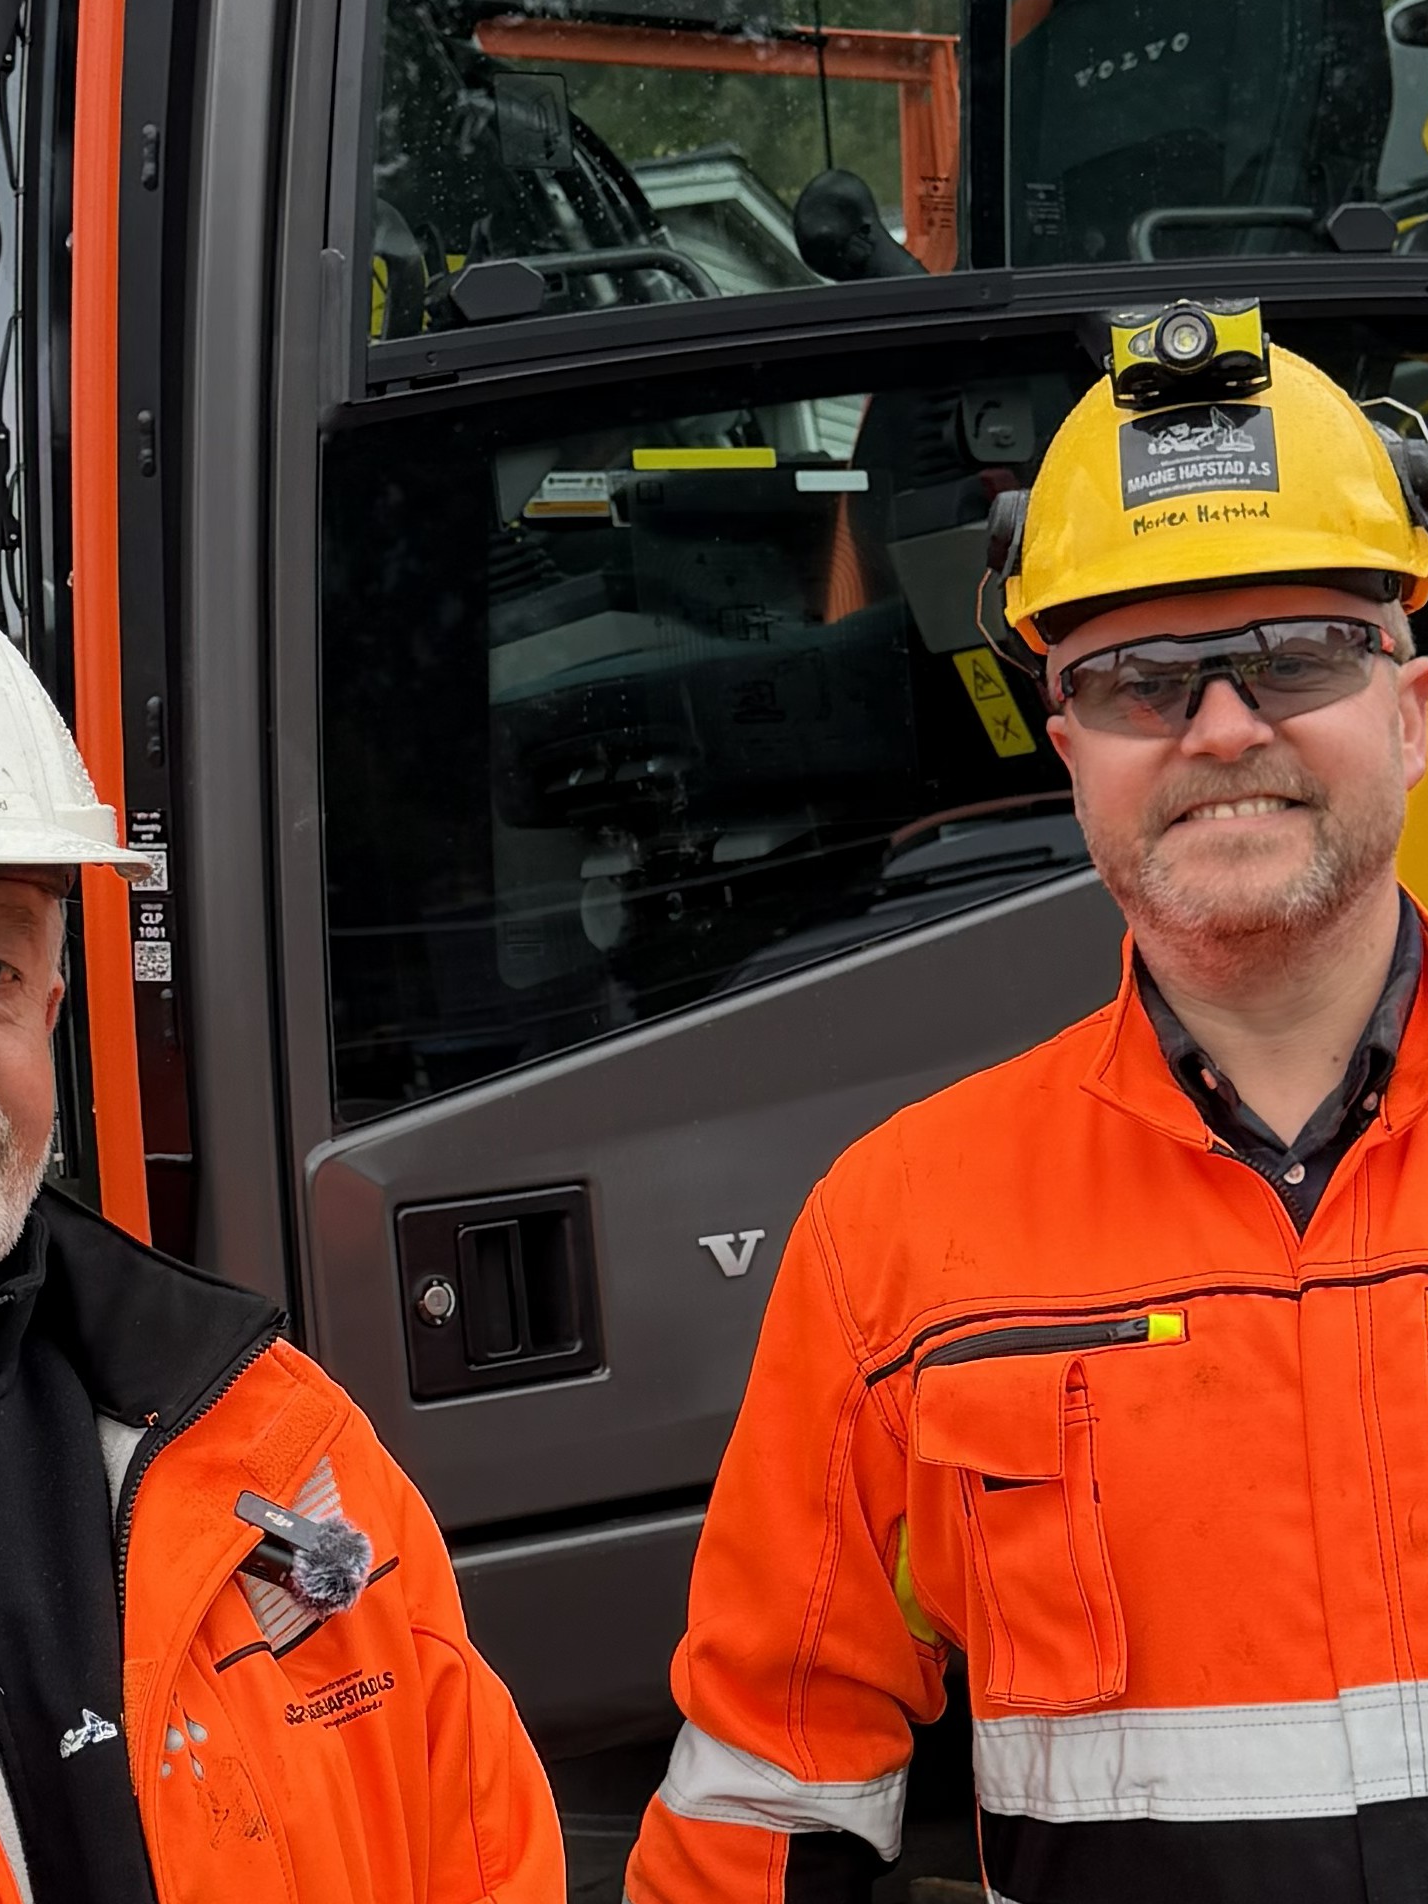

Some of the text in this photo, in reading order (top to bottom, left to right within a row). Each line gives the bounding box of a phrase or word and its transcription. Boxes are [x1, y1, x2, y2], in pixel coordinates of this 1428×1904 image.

[1074, 32, 1190, 88] VOLVO
[1127, 467, 1176, 493] MAGNE
[1178, 460, 1244, 480] HAFSTAD
[140, 912, 164, 925] CLP
